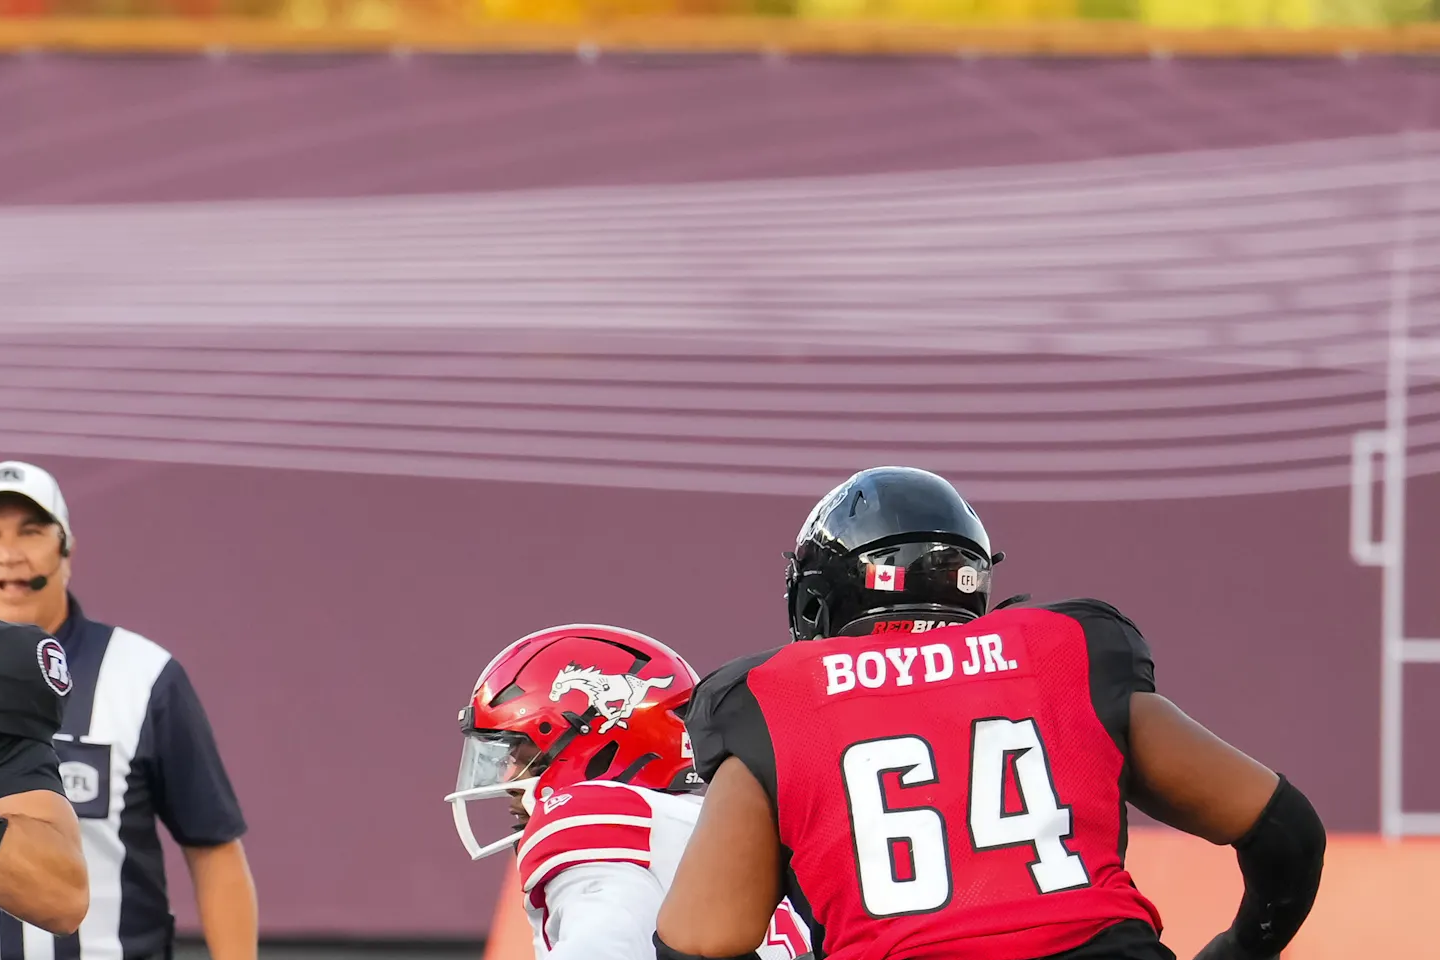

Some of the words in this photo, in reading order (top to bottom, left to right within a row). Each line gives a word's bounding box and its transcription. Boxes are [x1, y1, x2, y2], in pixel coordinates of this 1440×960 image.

[961, 574, 975, 586] CFL
[822, 643, 954, 696] BOYD
[962, 633, 1018, 676] JR.
[840, 717, 1092, 919] 64
